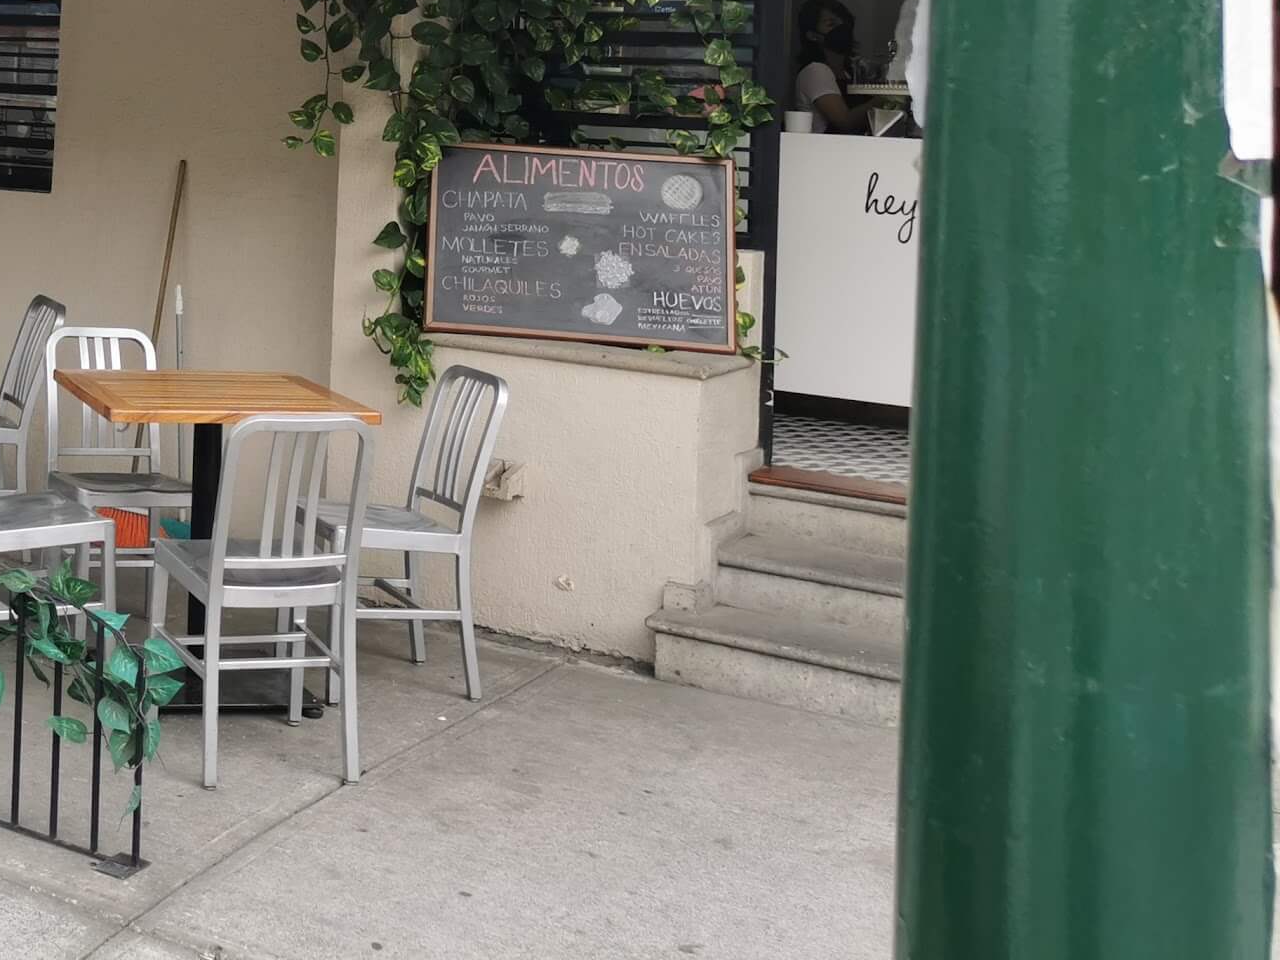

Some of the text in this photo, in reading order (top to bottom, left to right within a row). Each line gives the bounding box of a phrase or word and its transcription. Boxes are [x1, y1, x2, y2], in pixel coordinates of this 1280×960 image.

[472, 153, 645, 192] ALIMENTOS
[441, 189, 528, 211] CHAPATA
[463, 212, 495, 222] PAVO
[639, 209, 720, 228] WAFFLES
[623, 224, 720, 246] HOT CAKES
[441, 236, 549, 257] MOLLETES
[619, 241, 720, 265] ENSALADAS
[441, 275, 562, 300] CHILAQUILES
[463, 294, 496, 303] ROJOS
[462, 303, 503, 315] VERDES
[653, 290, 722, 313] HUEVOS
